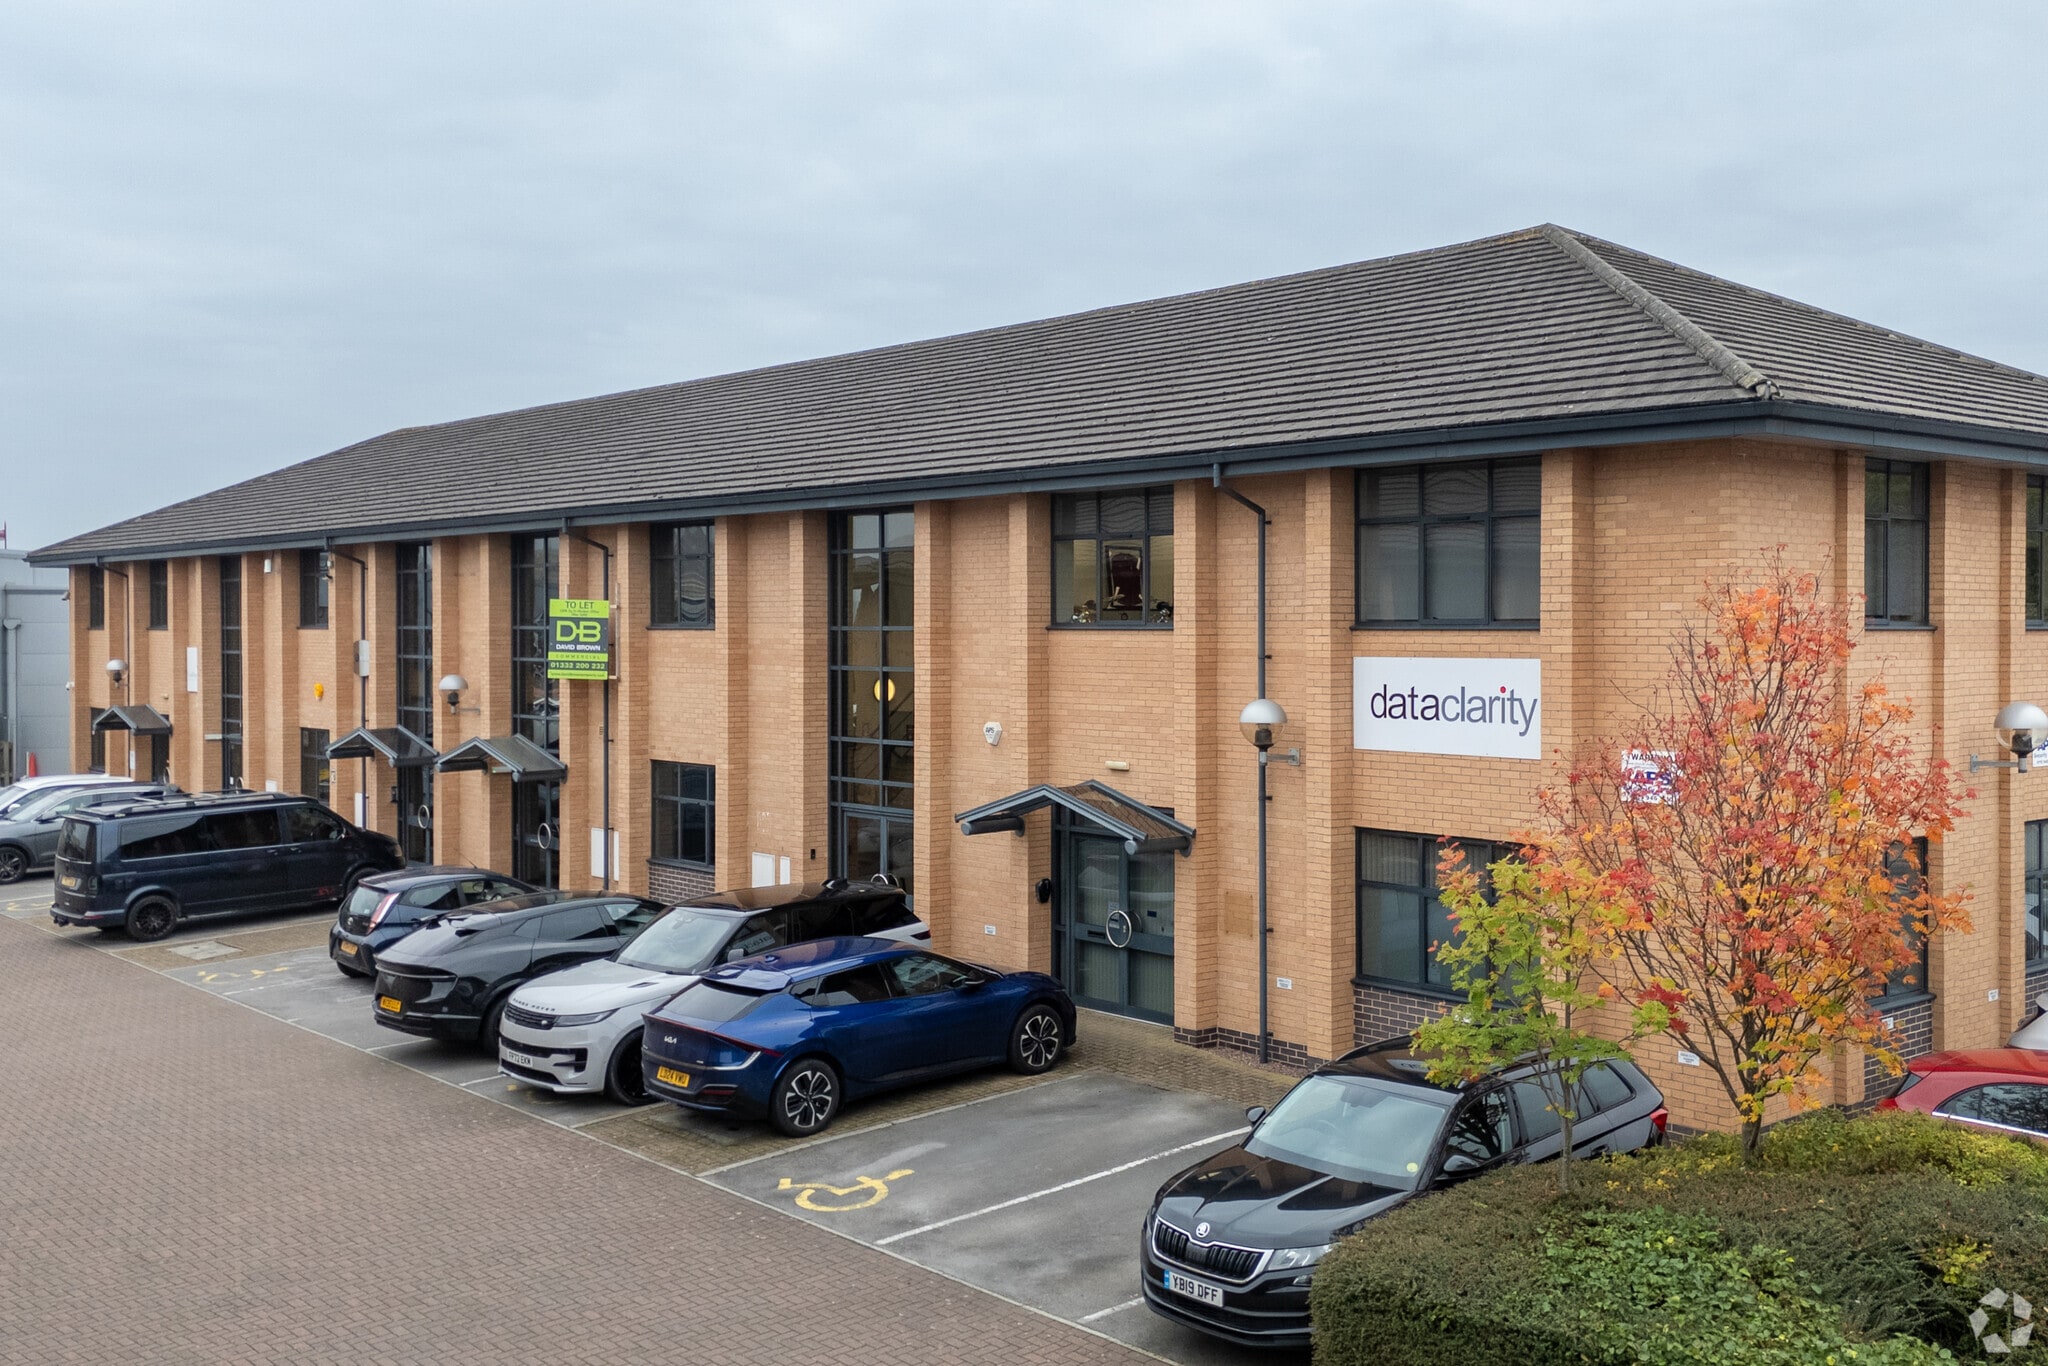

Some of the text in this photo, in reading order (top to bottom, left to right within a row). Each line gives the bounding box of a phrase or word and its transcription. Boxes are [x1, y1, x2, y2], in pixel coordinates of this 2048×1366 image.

[565, 601, 576, 609] TO
[1370, 684, 1538, 737] dataclarity
[1172, 1274, 1218, 1301] YB19 DFF
